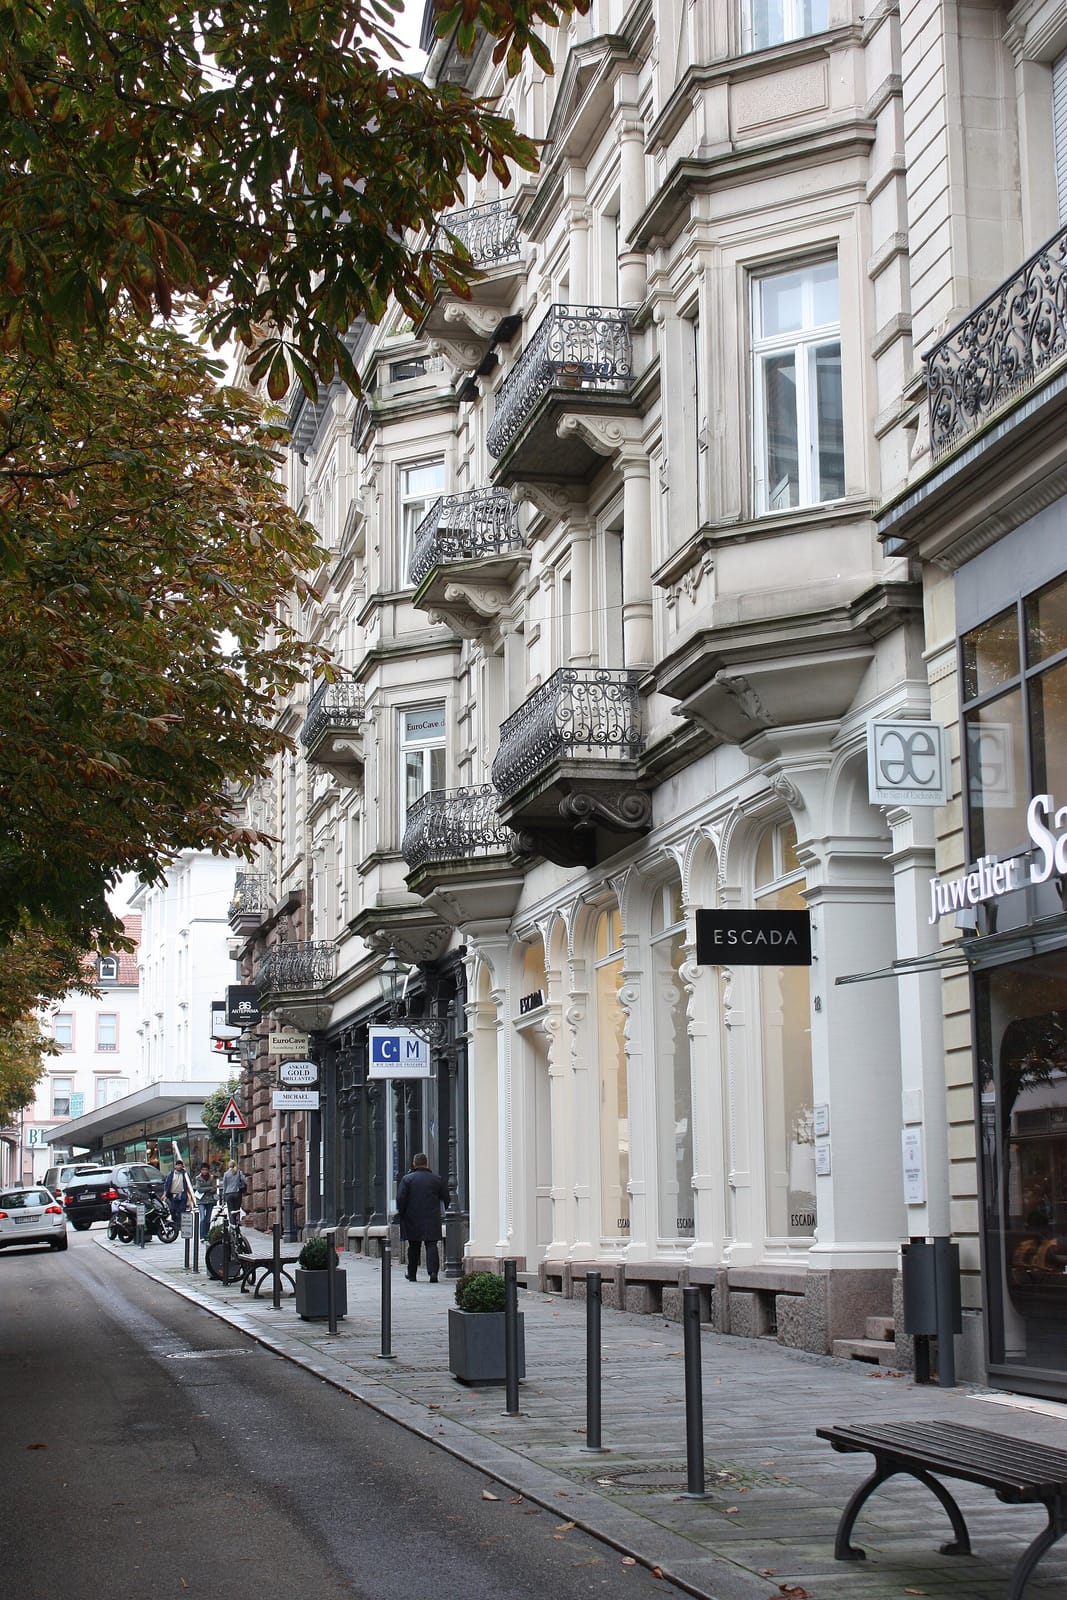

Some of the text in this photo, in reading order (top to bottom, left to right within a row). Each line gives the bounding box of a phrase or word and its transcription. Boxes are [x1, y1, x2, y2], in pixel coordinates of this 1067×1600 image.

[928, 855, 1015, 924] Juwelier
[713, 929, 798, 946] ESCADA
[382, 1041, 391, 1058] C
[407, 1041, 419, 1057] M
[791, 1214, 815, 1226] ESCADA
